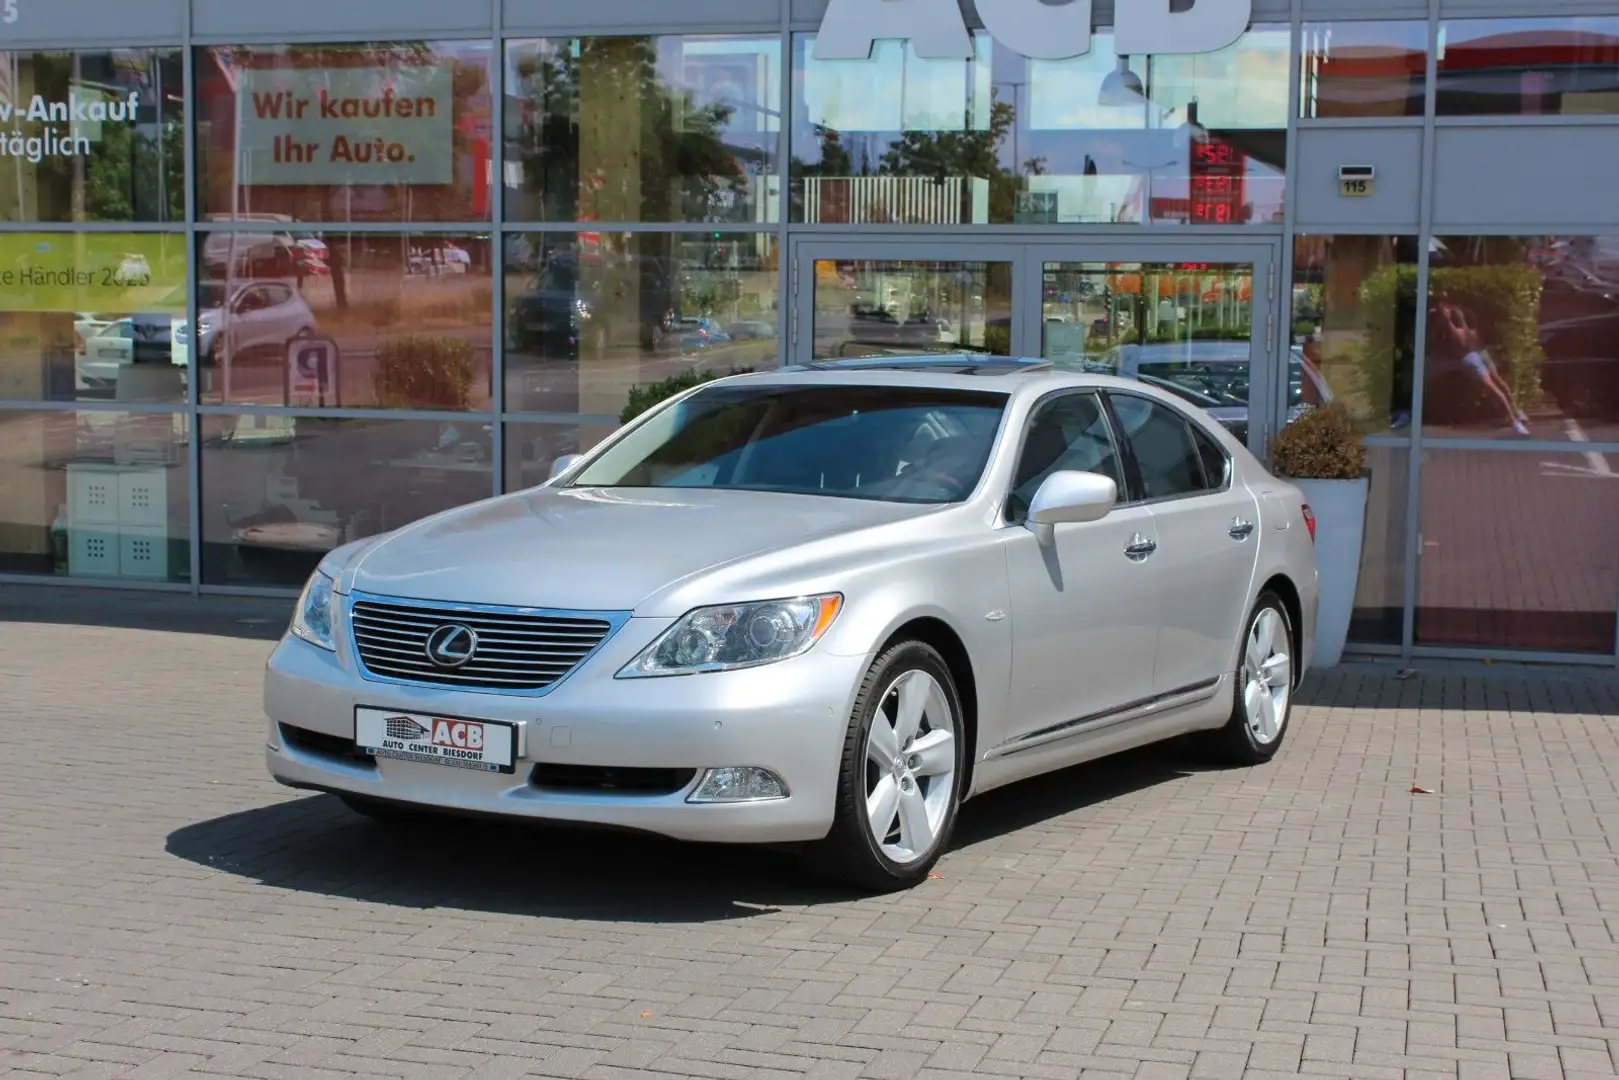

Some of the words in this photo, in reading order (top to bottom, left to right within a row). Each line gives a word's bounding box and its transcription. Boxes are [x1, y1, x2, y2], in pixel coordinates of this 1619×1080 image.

[252, 91, 309, 119] Wir
[320, 87, 436, 118] kaufen
[0, 127, 90, 163] täglich
[273, 134, 319, 163] Ihr
[328, 134, 415, 163] Auto.
[1343, 180, 1366, 193] 115
[20, 265, 96, 286] Händler
[433, 720, 483, 749] ACB
[382, 739, 404, 750] AUTO
[408, 743, 438, 755] CENTER
[443, 747, 483, 761] BIESDORF
